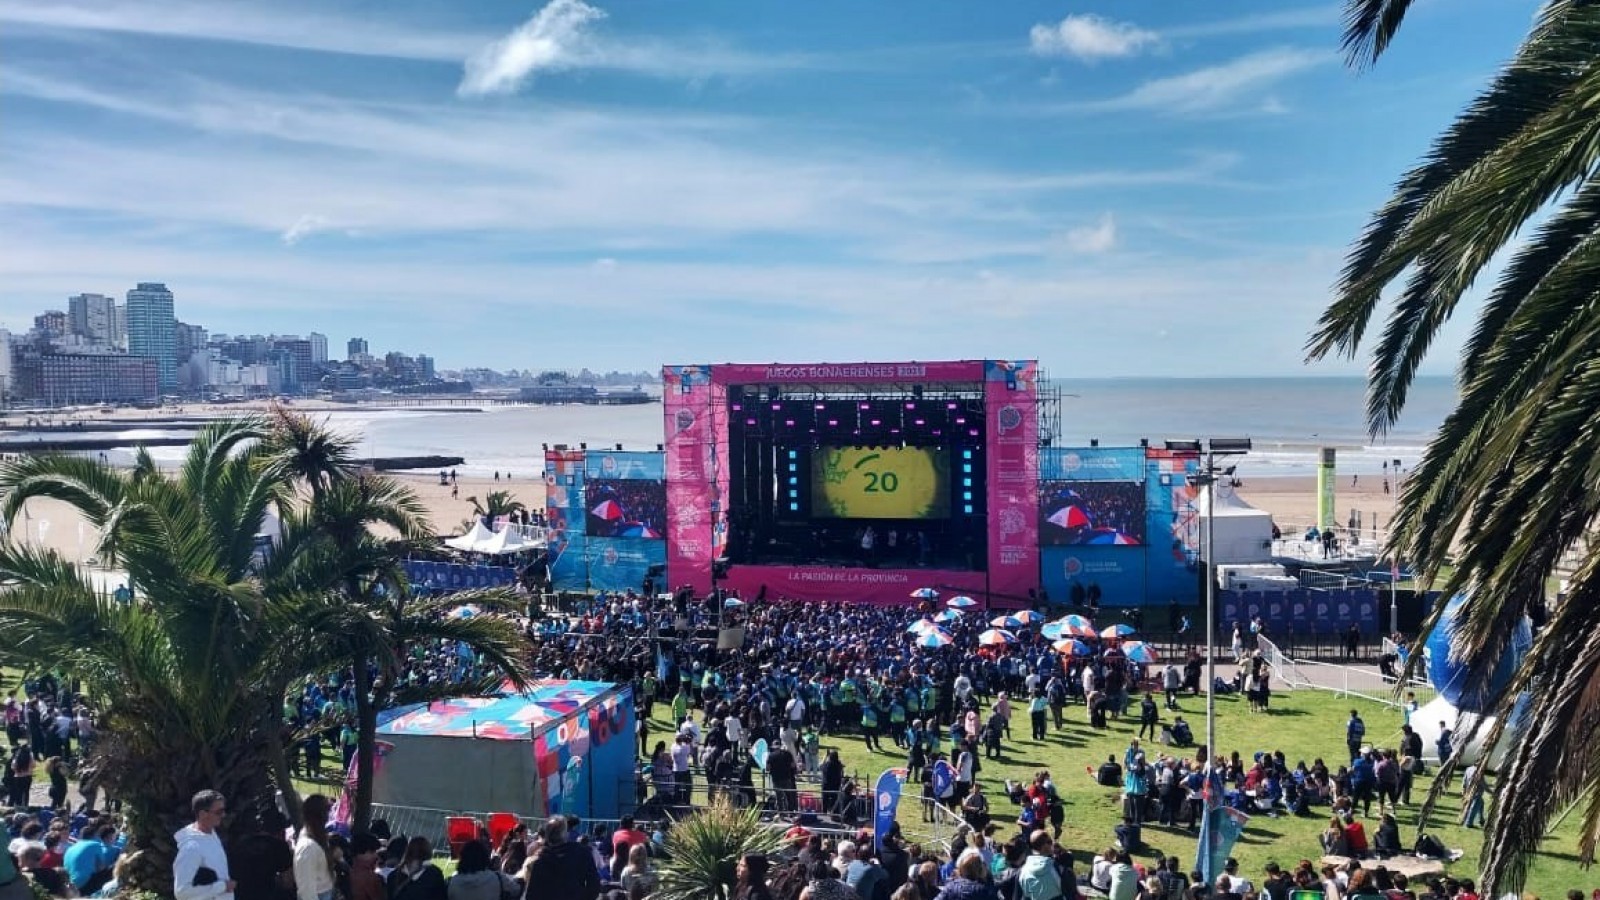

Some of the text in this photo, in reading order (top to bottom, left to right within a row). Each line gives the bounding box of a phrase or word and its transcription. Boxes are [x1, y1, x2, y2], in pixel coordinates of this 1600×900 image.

[766, 366, 806, 378] JUEGOS
[810, 366, 894, 378] BONAERENSES
[863, 472, 898, 493] 20
[788, 572, 800, 580] LA
[848, 573, 859, 581] LA
[862, 574, 908, 583] PROVINCIA
